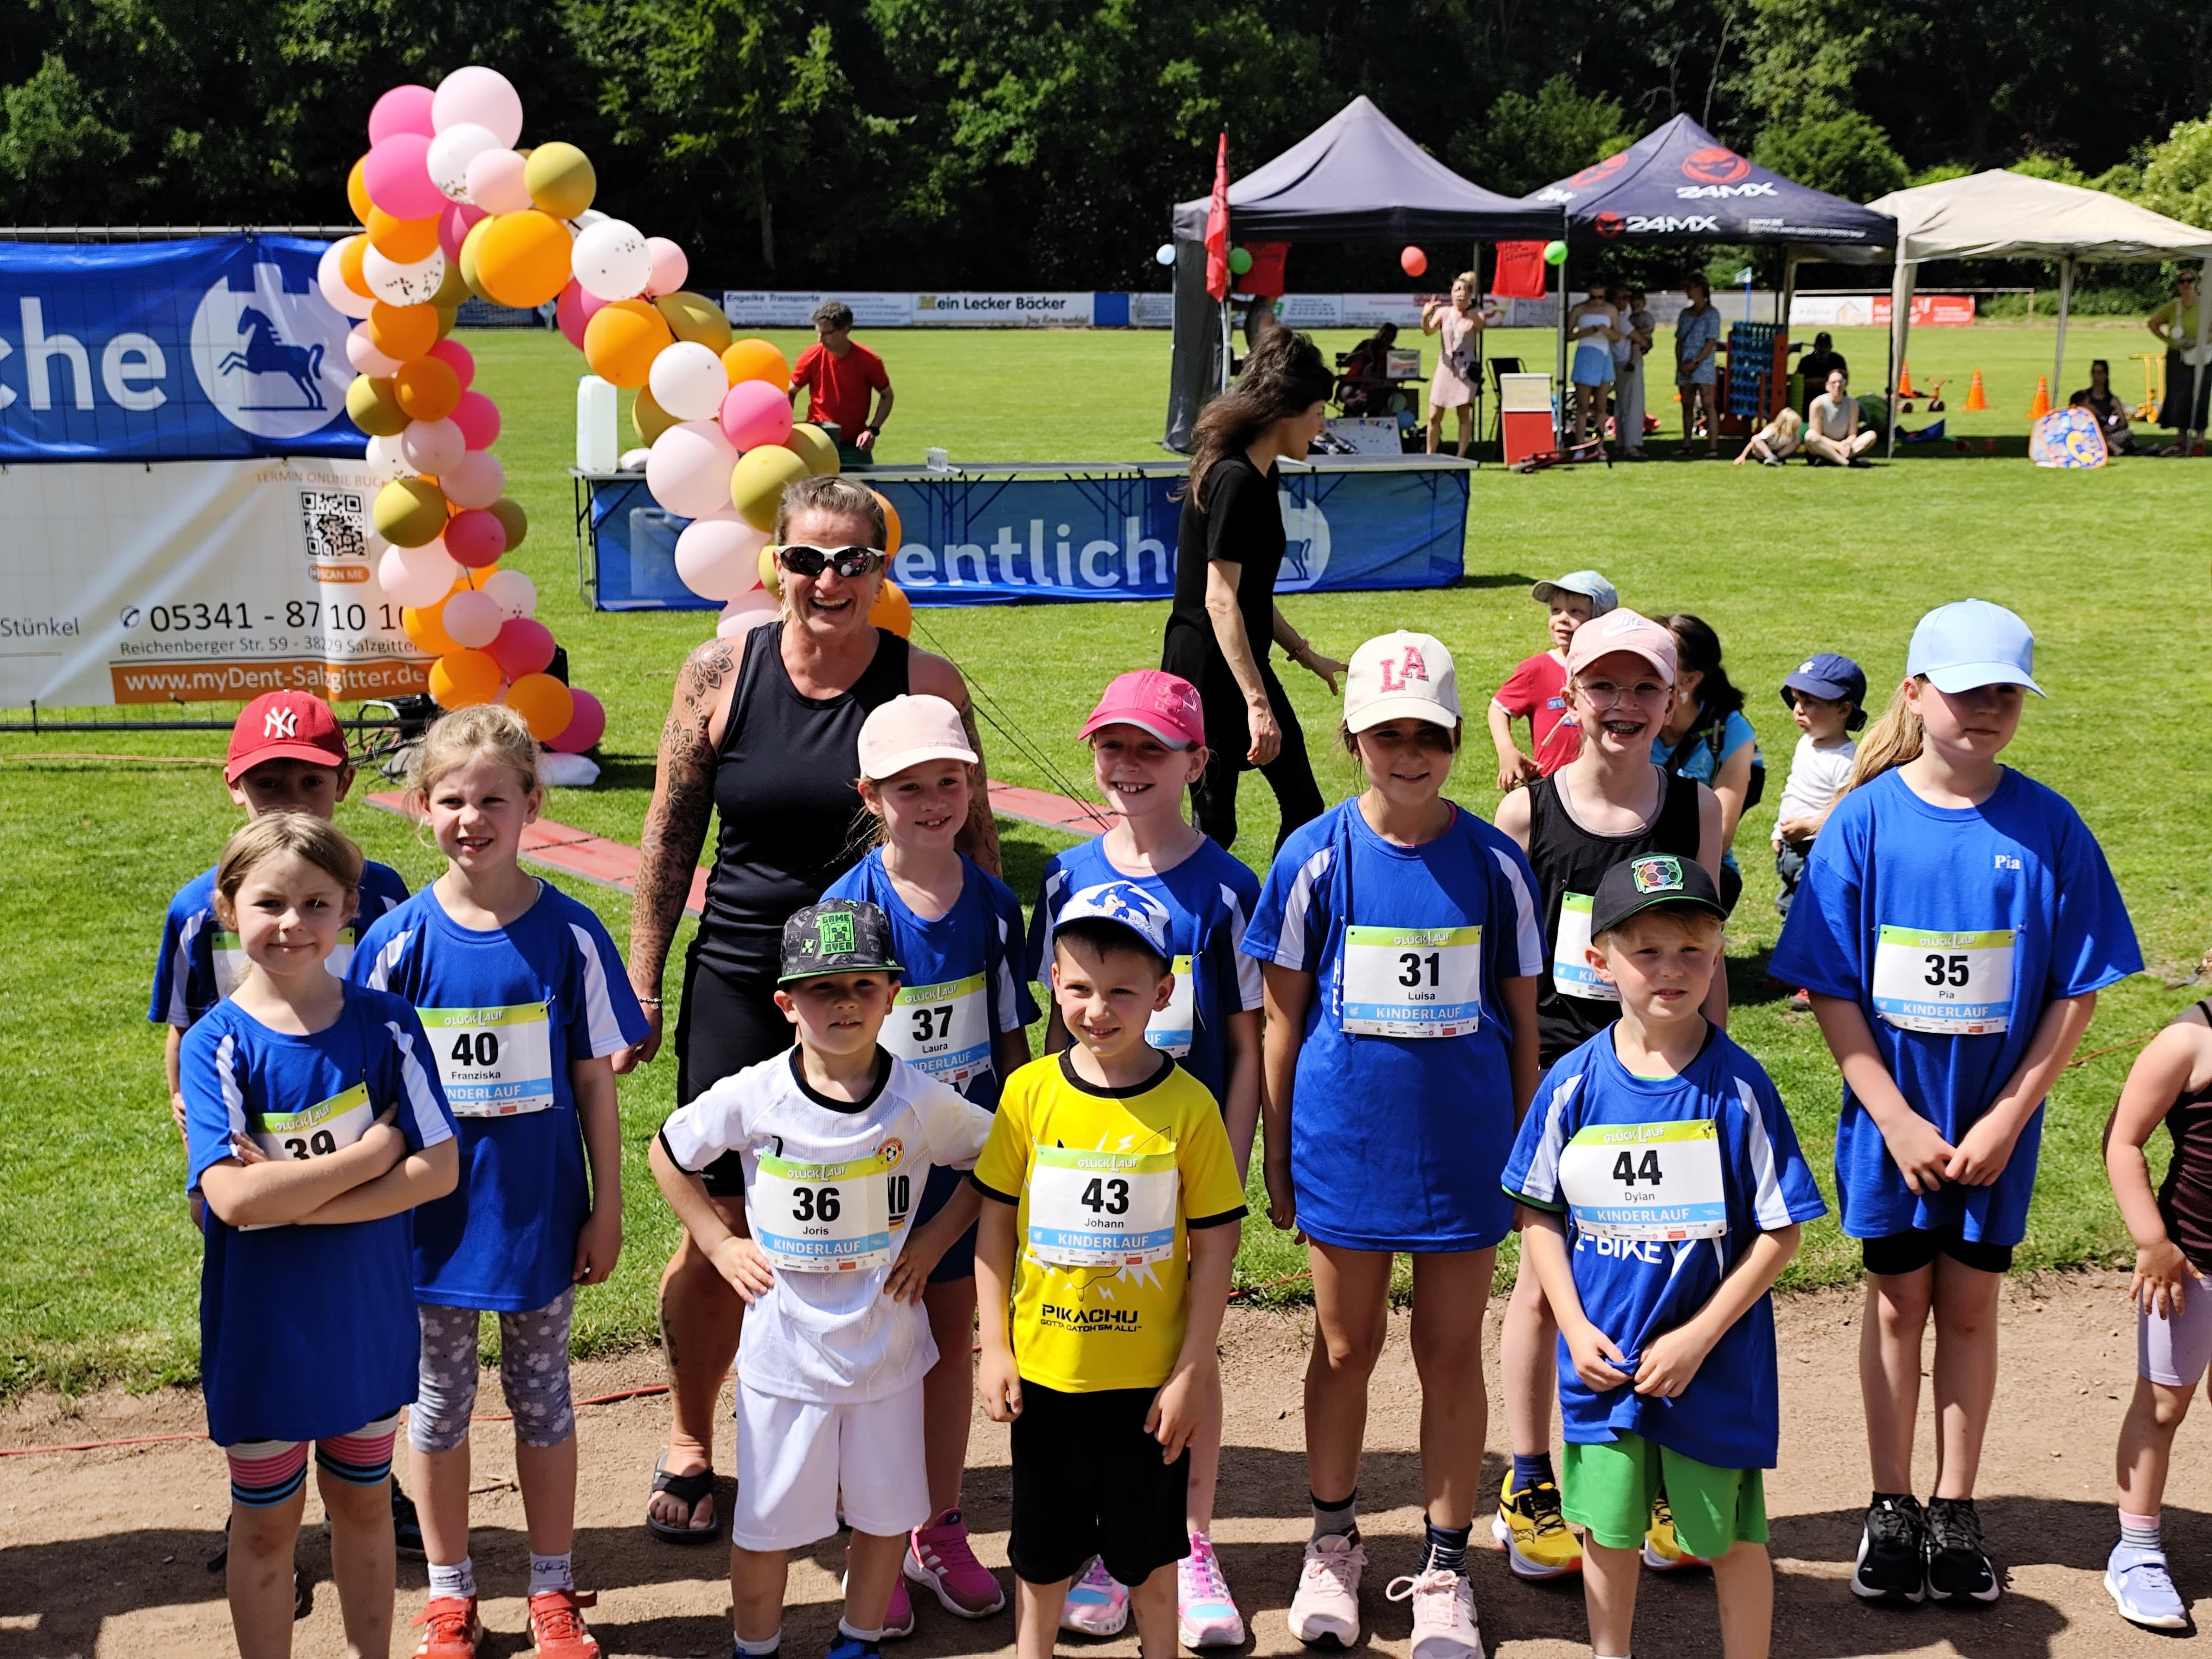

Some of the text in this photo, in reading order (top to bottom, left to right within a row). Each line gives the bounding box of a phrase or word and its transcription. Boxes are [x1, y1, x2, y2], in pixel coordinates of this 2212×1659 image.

[1675, 182, 1779, 199] 24MX
[1626, 215, 1721, 233] 24MX
[964, 297, 1012, 310] Lecker
[255, 471, 302, 483] TERMIN
[307, 472, 351, 486] ONLINE
[894, 516, 1177, 587] entlich
[320, 569, 363, 580] SCAN ME
[150, 601, 253, 633] 05341
[286, 601, 320, 627] 87
[330, 603, 365, 631] 10
[1, 616, 80, 637] Stünkel
[120, 638, 234, 655] Reichenberger
[240, 636, 263, 651] Str.
[269, 636, 287, 651] 59
[1380, 646, 1429, 693] LA
[124, 665, 426, 694] www.myDent-Salzgitter.de
[263, 706, 297, 738] NY
[1994, 854, 2021, 870] Pia
[822, 914, 850, 923] GAME
[825, 942, 853, 952] OVER
[1399, 953, 1439, 987] 31
[1925, 955, 1969, 987] 35
[1408, 992, 1436, 1000] Luisa
[1939, 991, 1954, 999] Pia
[1376, 1007, 1461, 1020] KINDERLAUF
[1903, 1003, 1989, 1018] KINDERLAUF
[912, 1005, 953, 1041] 37
[452, 1032, 498, 1066] 40
[922, 1043, 948, 1053] Laura
[452, 1071, 500, 1080] Franziska
[444, 1085, 521, 1099] NDERLAUF
[284, 1130, 336, 1160] 39
[1613, 1150, 1663, 1186] 44
[888, 1175, 909, 1214] ND
[1082, 1178, 1129, 1214] 43
[1625, 1192, 1655, 1203] Dylan
[793, 1187, 840, 1221] 36
[1085, 1218, 1124, 1228] Johann
[1597, 1207, 1690, 1222] KINDERLAUF
[803, 1226, 829, 1235] Joris
[774, 1238, 861, 1255] KINDERLAUF
[1058, 1233, 1149, 1248] KINDERLAUF
[1041, 1304, 1138, 1323] PIKACHU
[1040, 1319, 1065, 1328] GOTTA
